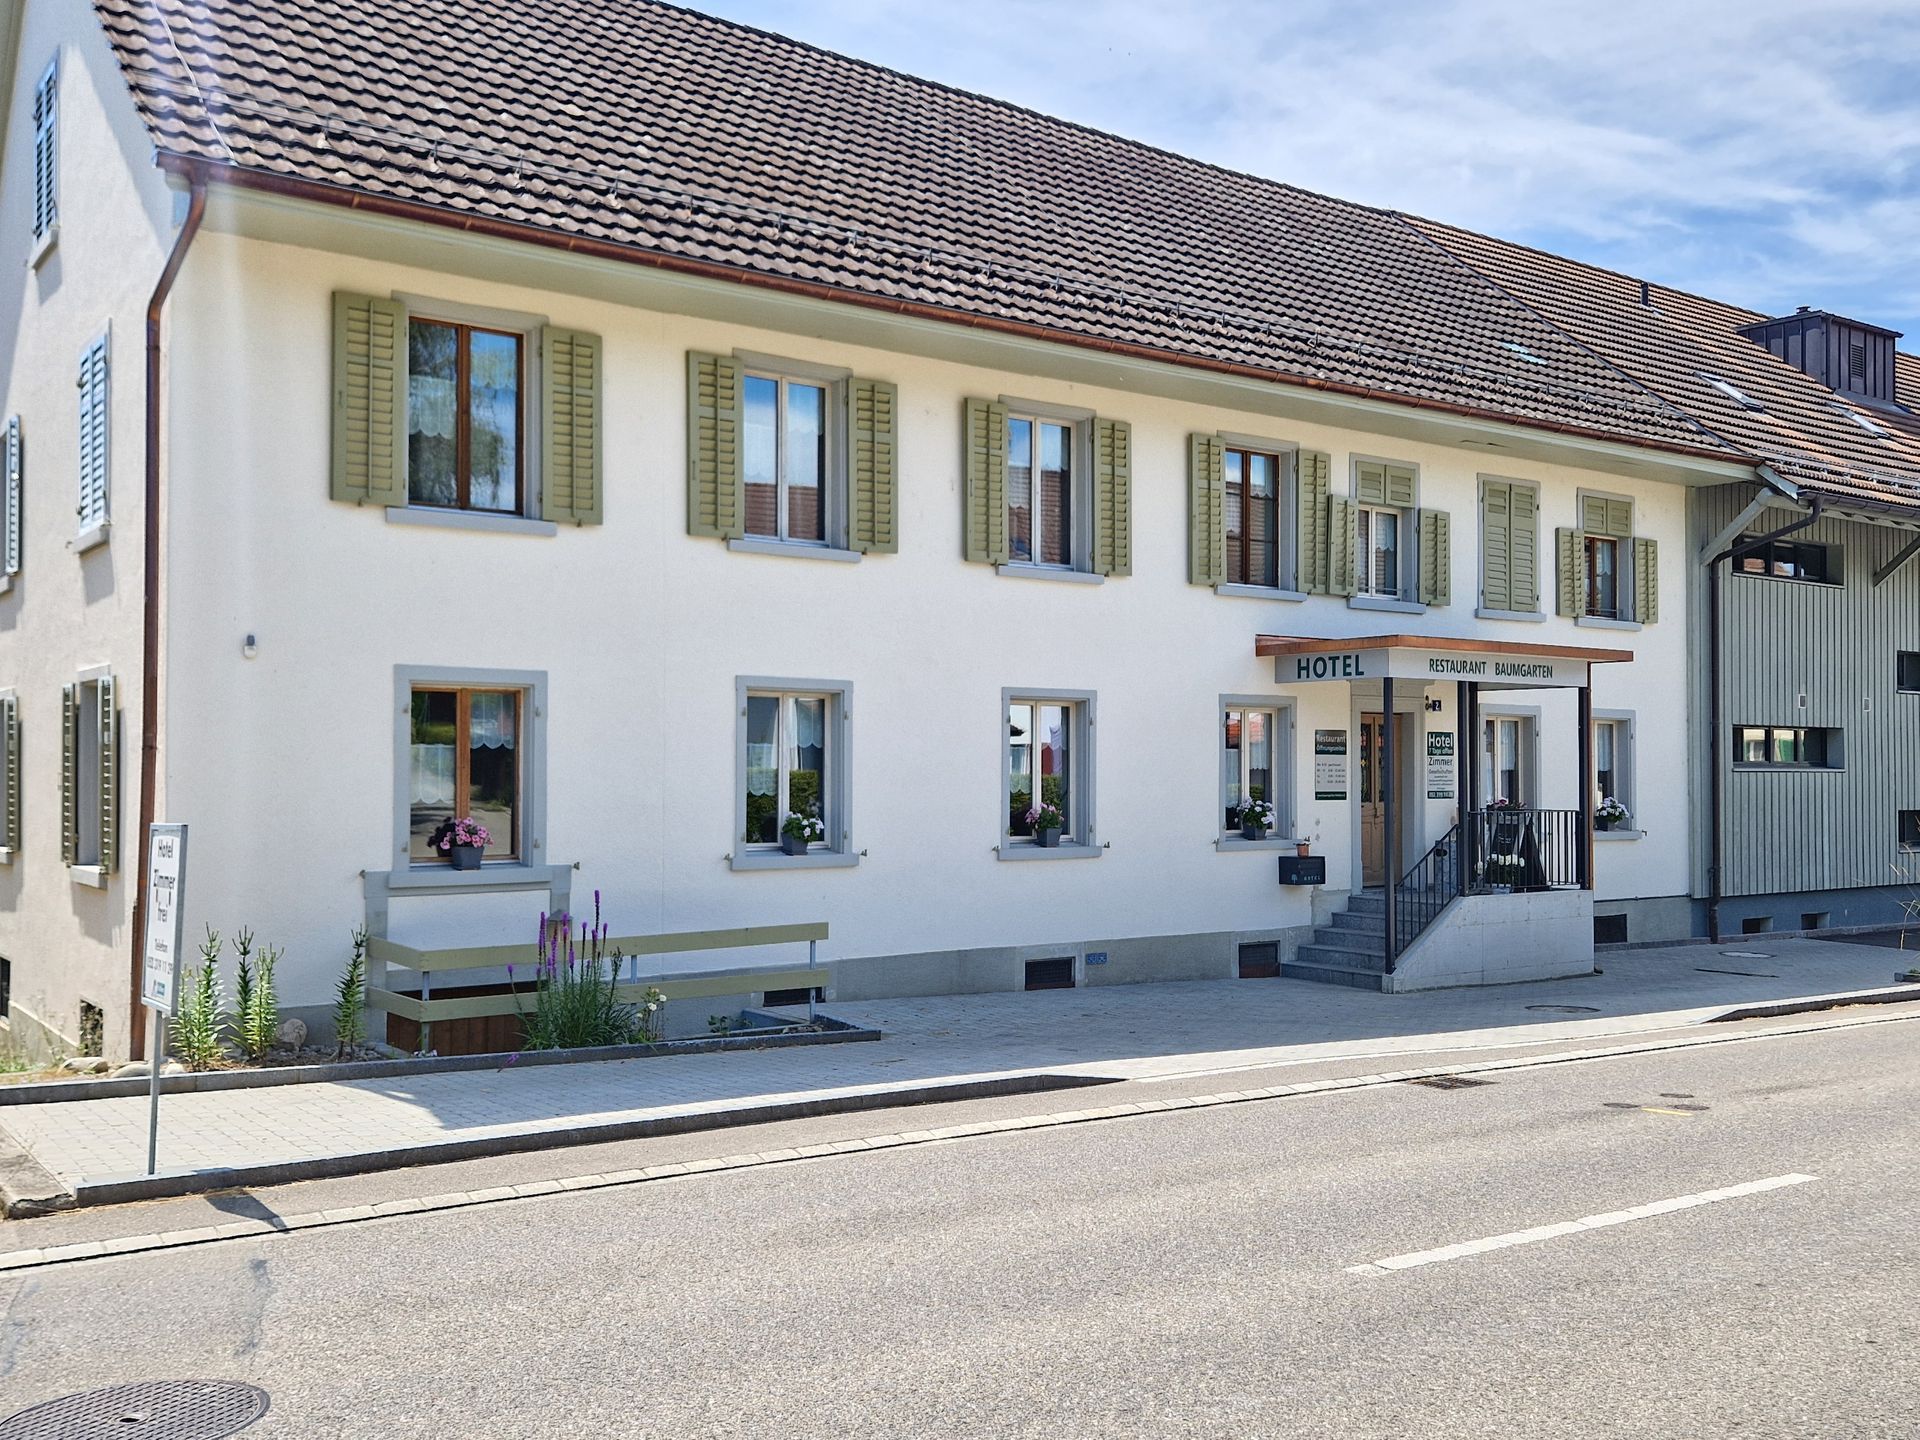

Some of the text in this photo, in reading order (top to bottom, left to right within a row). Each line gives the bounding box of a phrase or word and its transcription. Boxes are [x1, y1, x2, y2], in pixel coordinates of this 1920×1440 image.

[1296, 654, 1364, 680] HOTEL
[1428, 658, 1553, 679] RESTAURANT BAUMGARTEN
[1435, 701, 1440, 710] 2
[1316, 734, 1346, 743] Restaurant
[1428, 733, 1453, 747] Hotel
[1428, 756, 1453, 766] Zimmer
[158, 839, 174, 858] Hotel
[153, 869, 176, 890] Zimmer
[157, 902, 168, 922] frei
